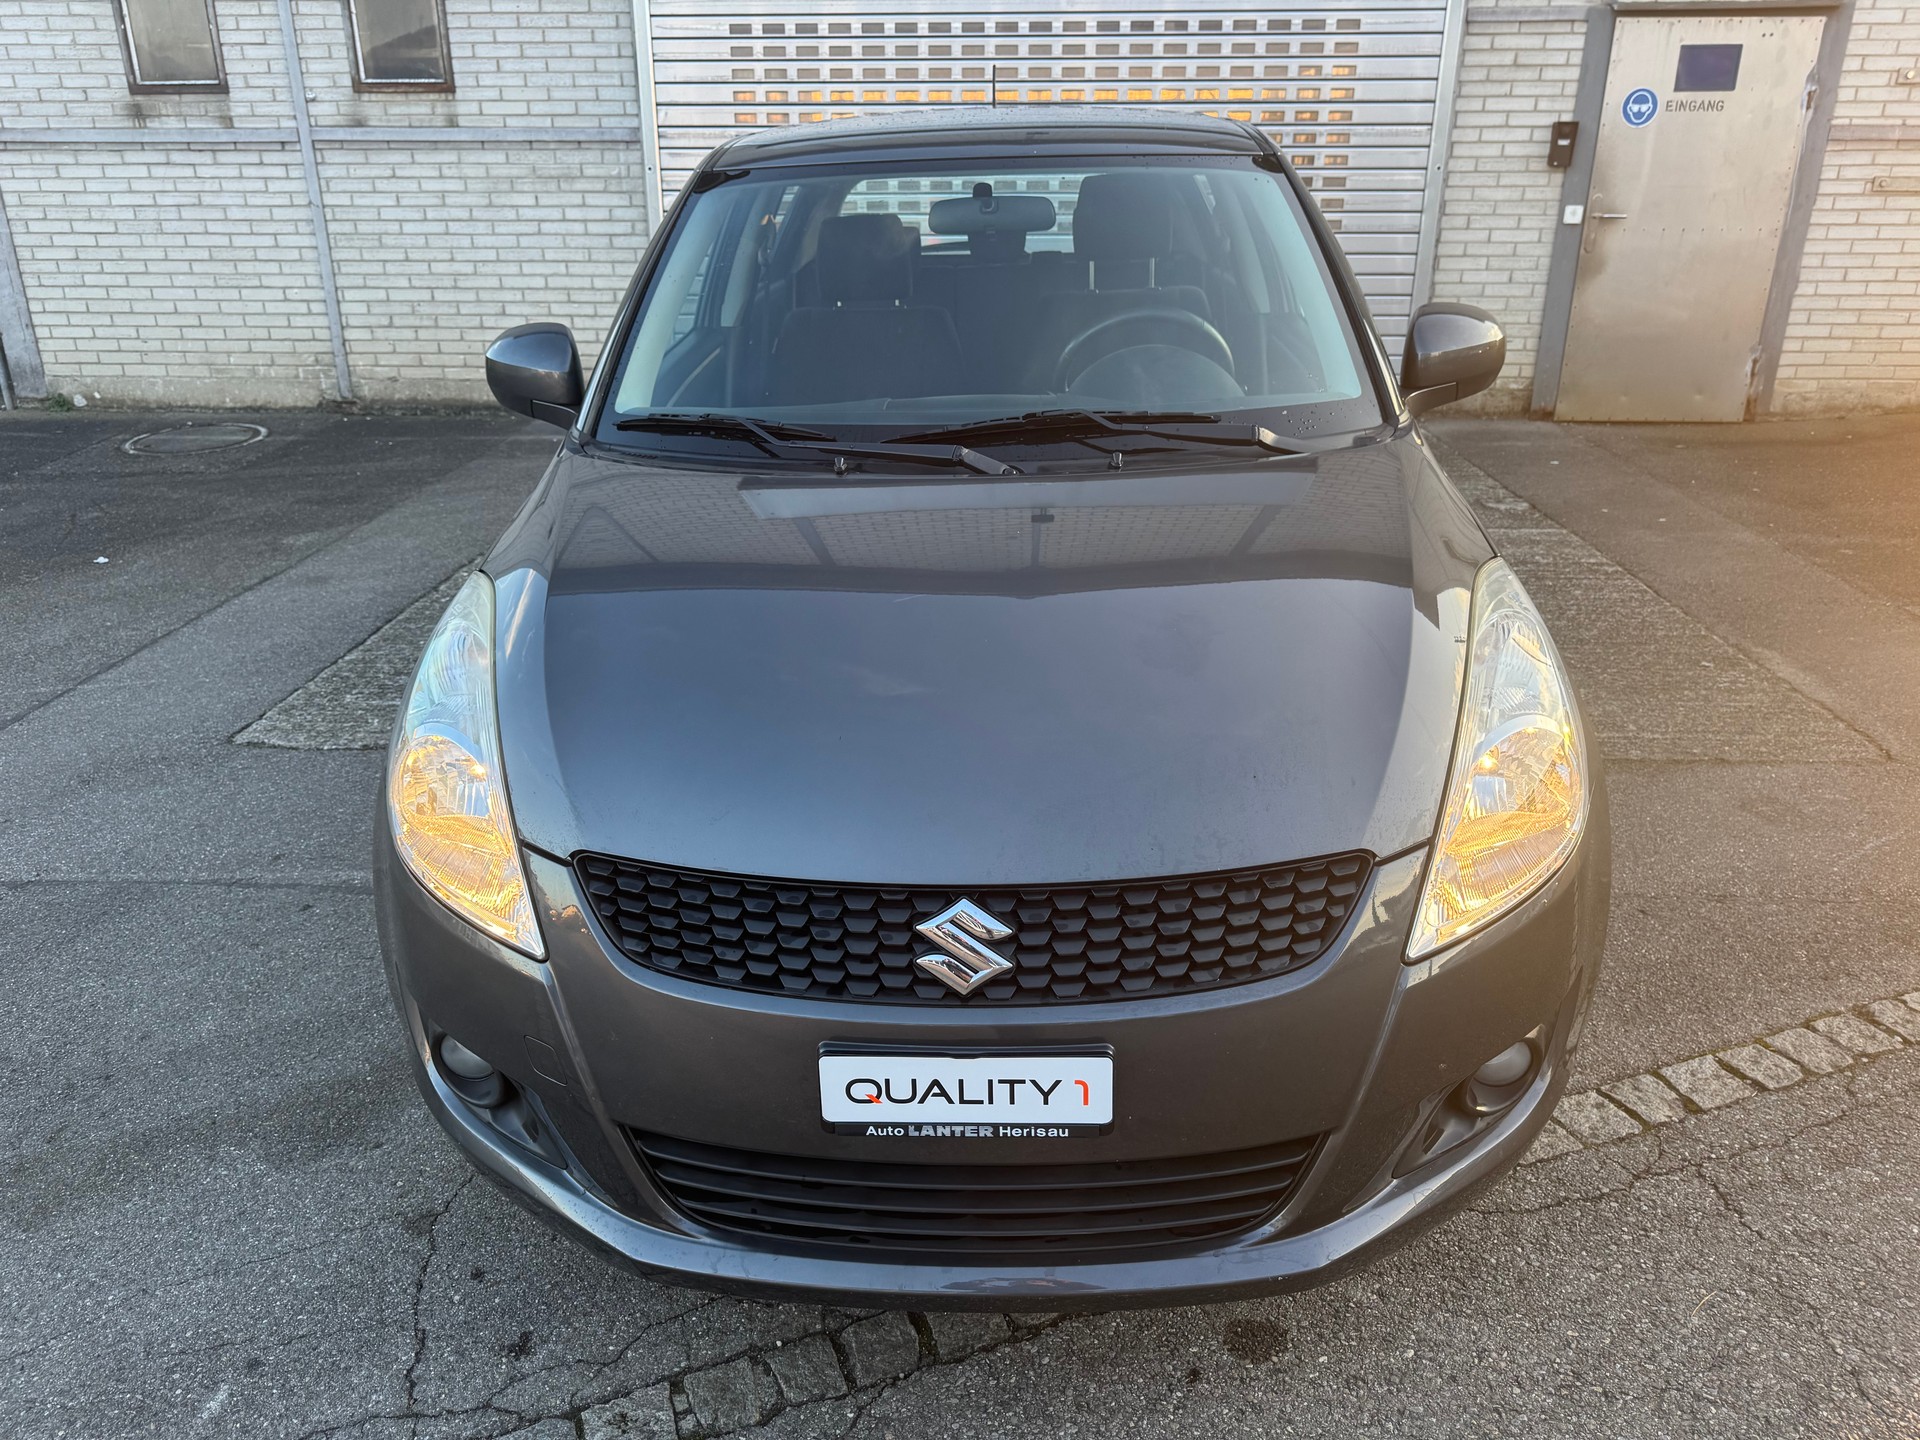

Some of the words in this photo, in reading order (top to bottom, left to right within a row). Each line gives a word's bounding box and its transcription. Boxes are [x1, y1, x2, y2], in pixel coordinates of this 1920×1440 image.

[1665, 100, 1724, 112] EINGANG
[845, 1078, 1063, 1106] QUALITY
[866, 1125, 905, 1137] Auto
[908, 1125, 994, 1138] LANTER
[999, 1126, 1069, 1138] Herisau
